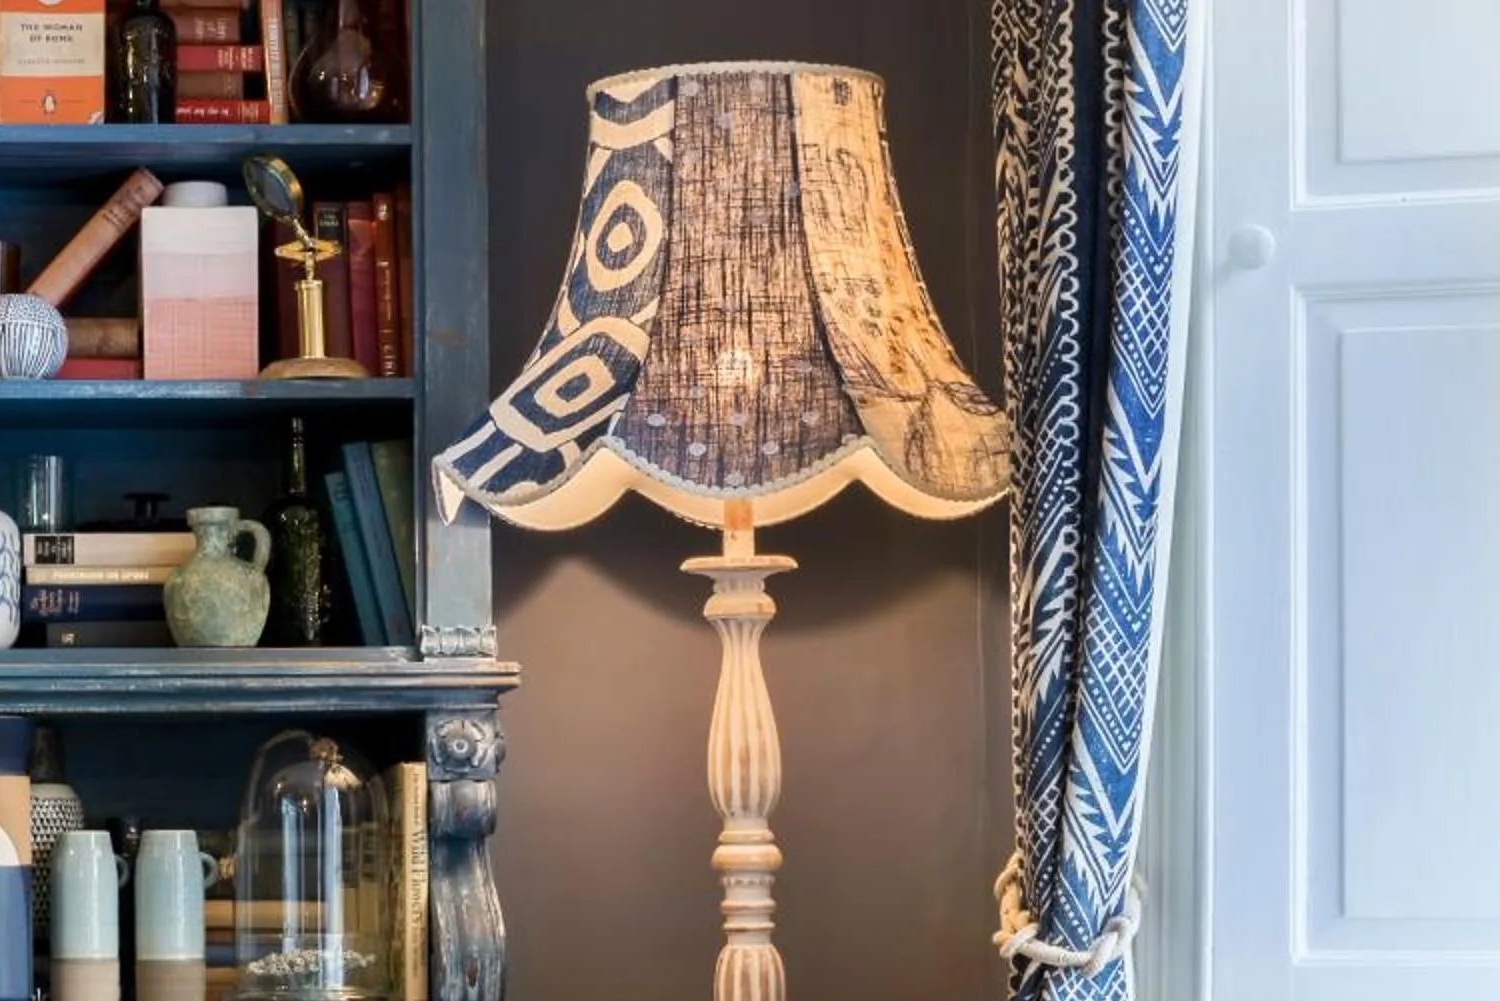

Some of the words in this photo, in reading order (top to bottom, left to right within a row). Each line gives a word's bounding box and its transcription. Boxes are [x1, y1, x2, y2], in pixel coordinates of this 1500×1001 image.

[20, 23, 39, 32] THE
[43, 23, 83, 32] WOMAN
[29, 35, 42, 43] OF
